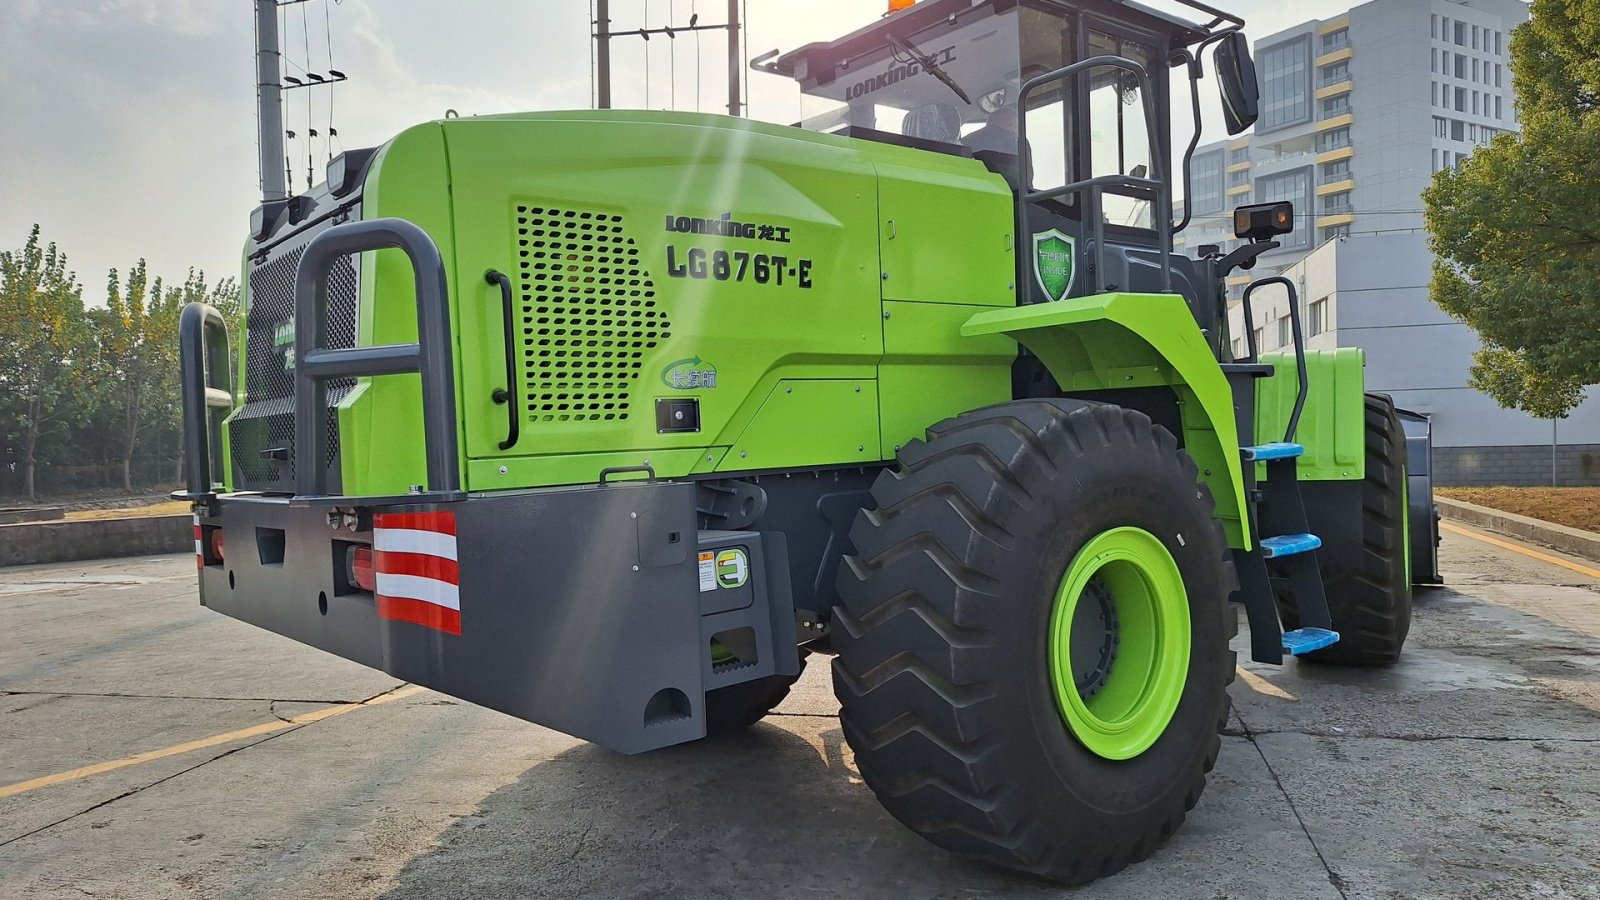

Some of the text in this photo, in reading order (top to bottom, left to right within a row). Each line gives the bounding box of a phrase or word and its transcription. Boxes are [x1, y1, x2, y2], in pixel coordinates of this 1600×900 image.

[665, 212, 791, 243] LONKING 龙工
[666, 245, 812, 289] LG876T-E
[1043, 265, 1068, 276] INSIDE
[671, 370, 717, 388] 长续航
